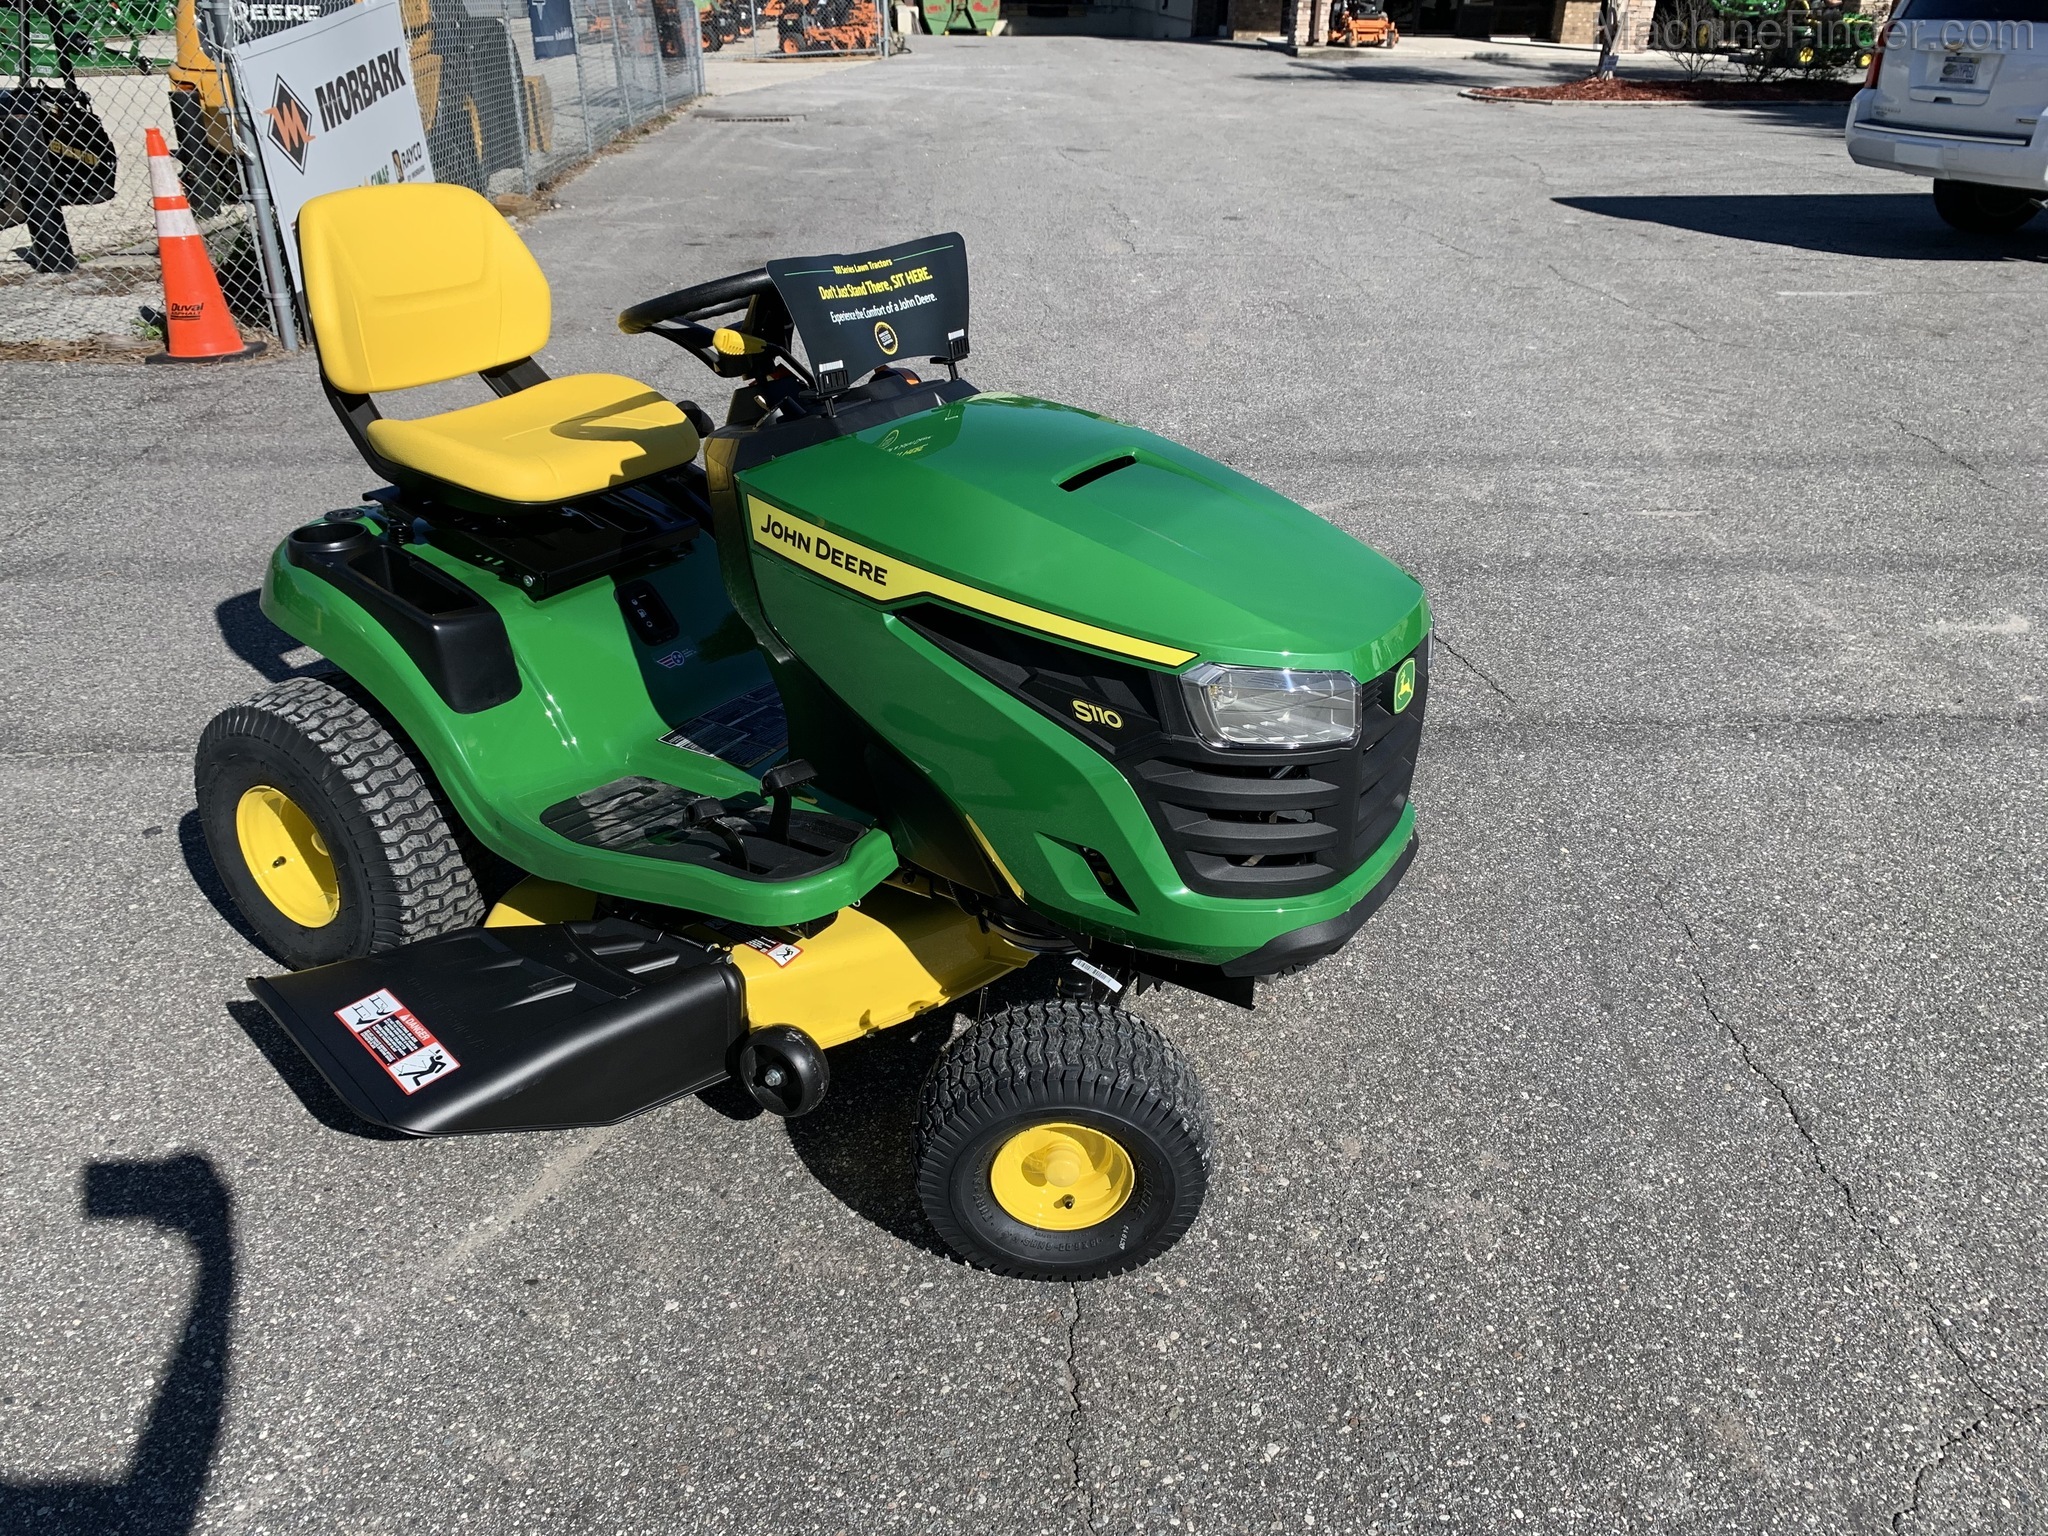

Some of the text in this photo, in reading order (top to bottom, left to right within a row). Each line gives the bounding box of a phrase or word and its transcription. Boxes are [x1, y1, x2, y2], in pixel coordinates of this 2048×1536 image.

[230, 3, 321, 21] DEERE
[314, 47, 407, 132] MORBARK
[401, 141, 422, 169] RAYCO
[854, 263, 869, 273] Lawn
[868, 259, 893, 270] Tractors
[818, 266, 933, 300] Don't Just Stand There, SIT HERE.
[171, 302, 204, 311] Duval
[829, 293, 938, 325] Experience the Comfort of a John Deere.
[761, 514, 888, 586] JOHN DEERE
[1072, 699, 1122, 728] S110
[405, 1017, 430, 1041] DANGER
